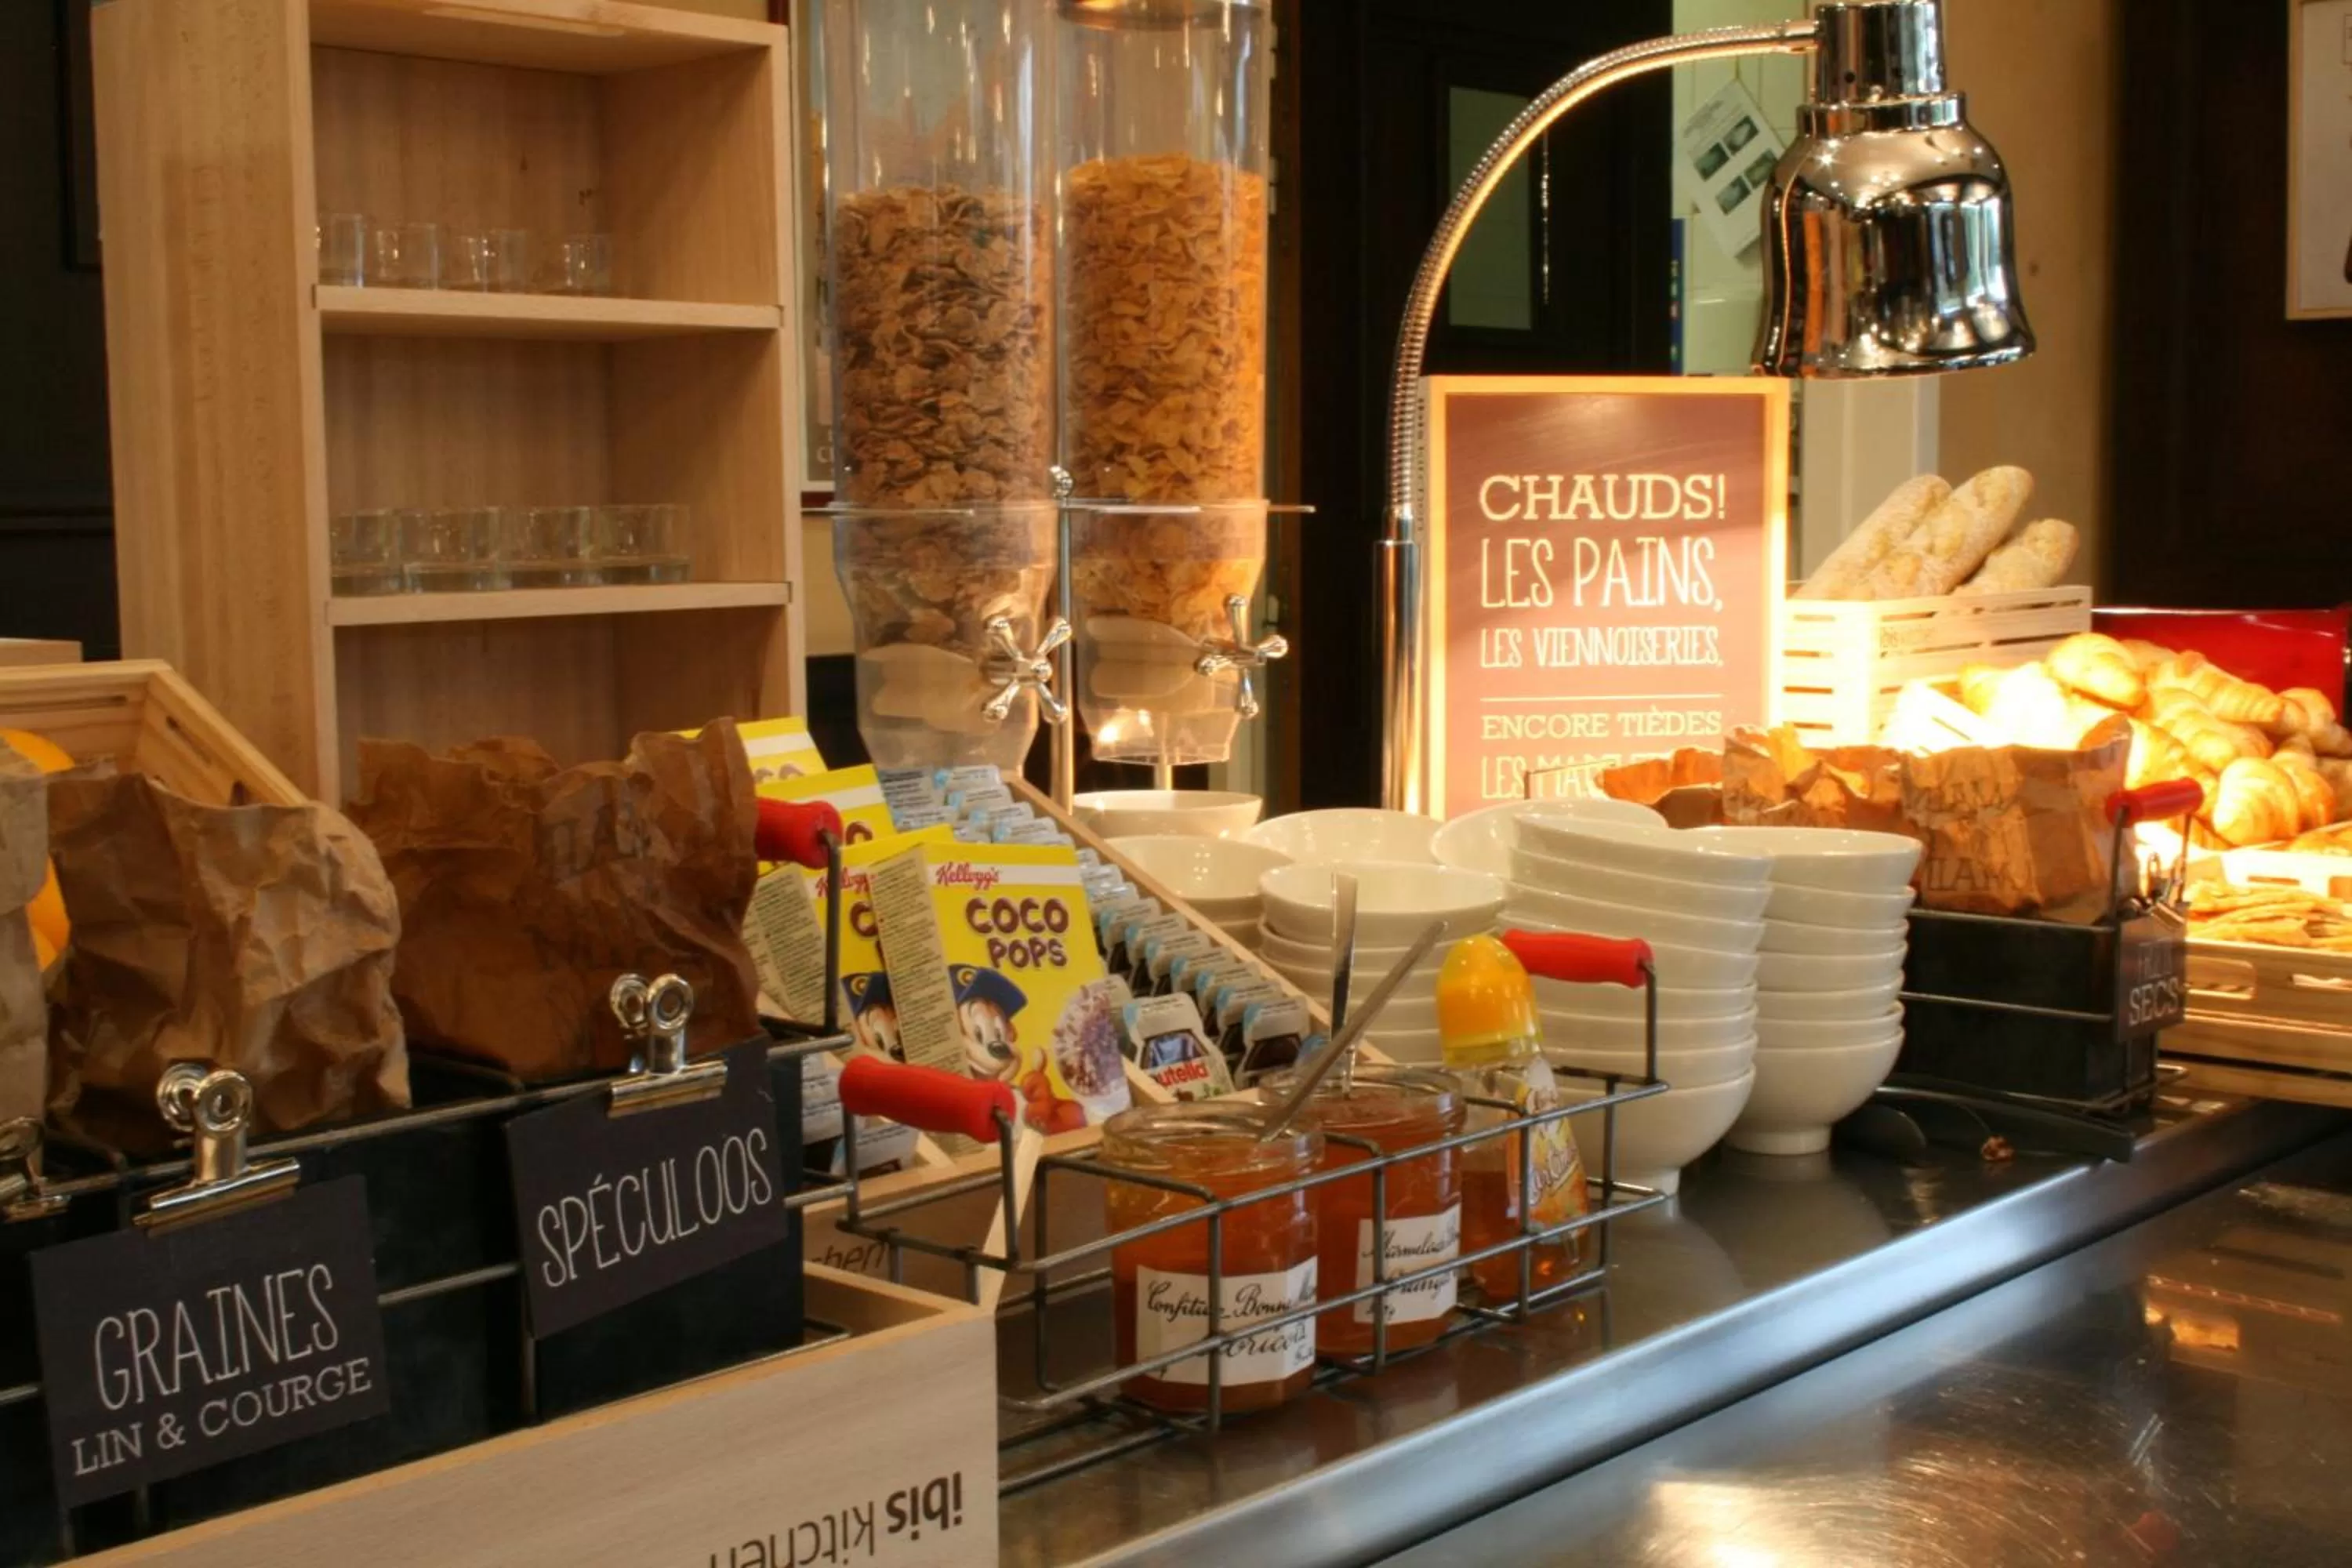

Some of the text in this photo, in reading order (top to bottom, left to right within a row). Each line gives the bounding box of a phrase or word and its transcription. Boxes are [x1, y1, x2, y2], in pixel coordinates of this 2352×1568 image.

[1479, 474, 1726, 521] CHAUDS!
[1480, 535, 1724, 613] LES PAINS,
[1480, 628, 1523, 668] LES
[1480, 705, 1722, 740] ENCORE TIÈDES
[935, 860, 1001, 891] Kellogg's
[965, 897, 1069, 934] COCO
[987, 936, 1067, 969] POPS
[1154, 1061, 1210, 1088] utella
[537, 1127, 772, 1288] SPÉCULOOS
[1147, 1280, 1231, 1323] Confitue
[93, 1264, 339, 1411] GRAINES
[71, 1358, 372, 1475] LIN & COURGE
[885, 1471, 963, 1541] ibis
